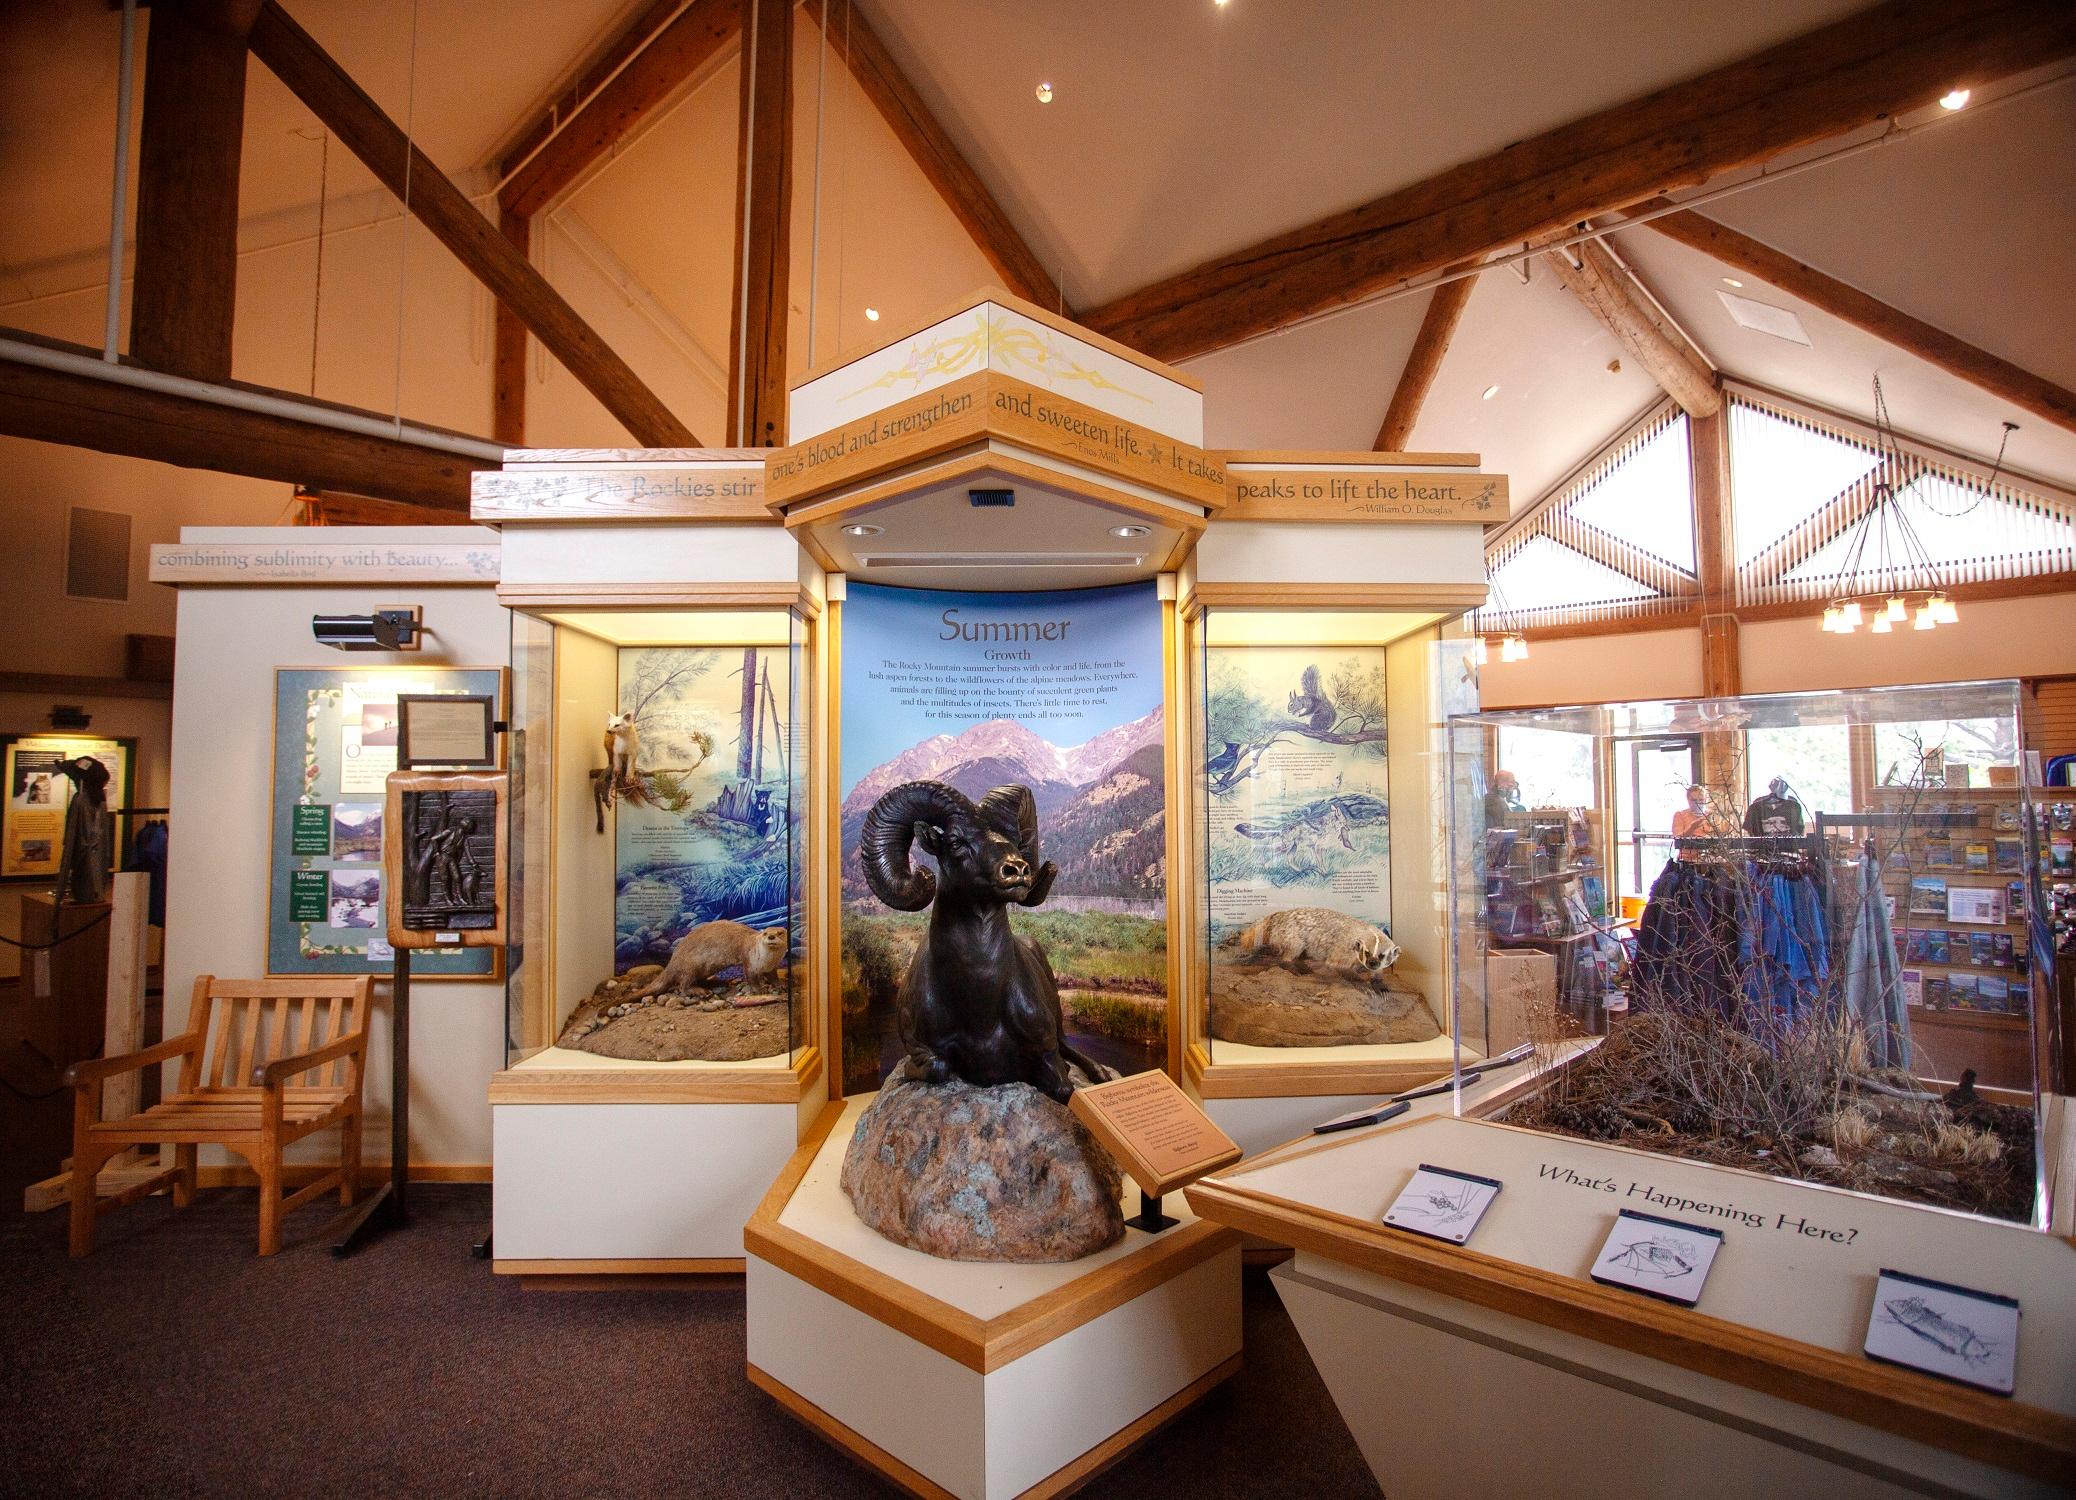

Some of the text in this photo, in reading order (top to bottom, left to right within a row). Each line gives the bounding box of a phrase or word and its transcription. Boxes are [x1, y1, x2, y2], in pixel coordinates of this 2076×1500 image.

[772, 392, 973, 481] one's blood and strengthen
[995, 391, 1224, 485] and sweeten life. It takes
[578, 476, 757, 497] The Rockies stir
[1236, 479, 1462, 502] peaks to lift the heart.
[158, 550, 249, 570] combining
[255, 550, 336, 569] sublimity
[342, 550, 381, 566] with
[939, 608, 1071, 642] Summer
[984, 649, 1031, 661] Growth
[882, 660, 898, 669] The
[899, 661, 922, 672] Rocky
[924, 662, 961, 672] Mountain
[962, 664, 995, 672] summer
[997, 664, 1021, 672] bursts
[1023, 664, 1040, 672] with
[1042, 663, 1061, 671] color
[1063, 662, 1077, 671] and
[1094, 661, 1112, 669] from
[1113, 659, 1125, 668] the
[868, 671, 884, 680] lush
[885, 674, 907, 682] aspen
[908, 674, 933, 683] forests
[935, 675, 944, 683] to
[945, 675, 958, 683] the
[960, 675, 1005, 684] wildflowers
[1006, 675, 1014, 684] of
[1016, 675, 1029, 684] the
[1030, 675, 1053, 685] alpine
[889, 685, 919, 693] animals
[935, 687, 957, 696] filling
[959, 689, 969, 697] up
[983, 687, 995, 696] the
[997, 687, 1025, 697] bounty
[1027, 687, 1035, 695] of
[1036, 687, 1072, 695] succulent
[1074, 687, 1095, 695] green
[1096, 685, 1117, 694] plants
[900, 698, 915, 706] and
[916, 698, 928, 706] the
[930, 698, 971, 707] multitudes
[973, 699, 981, 707] of
[1014, 699, 1042, 707] There's
[1044, 699, 1062, 707] little
[1063, 698, 1080, 706] time
[1082, 698, 1090, 706] to
[925, 710, 936, 719] for
[938, 710, 953, 719] this
[982, 710, 990, 719] of
[991, 711, 1016, 721] plenty
[1018, 711, 1036, 719] ends
[1038, 711, 1047, 719] all
[1064, 711, 1084, 719] soon.
[300, 806, 324, 816] Spring
[297, 872, 323, 880] Winter
[1538, 1164, 1859, 1245] What's Happening Here?
